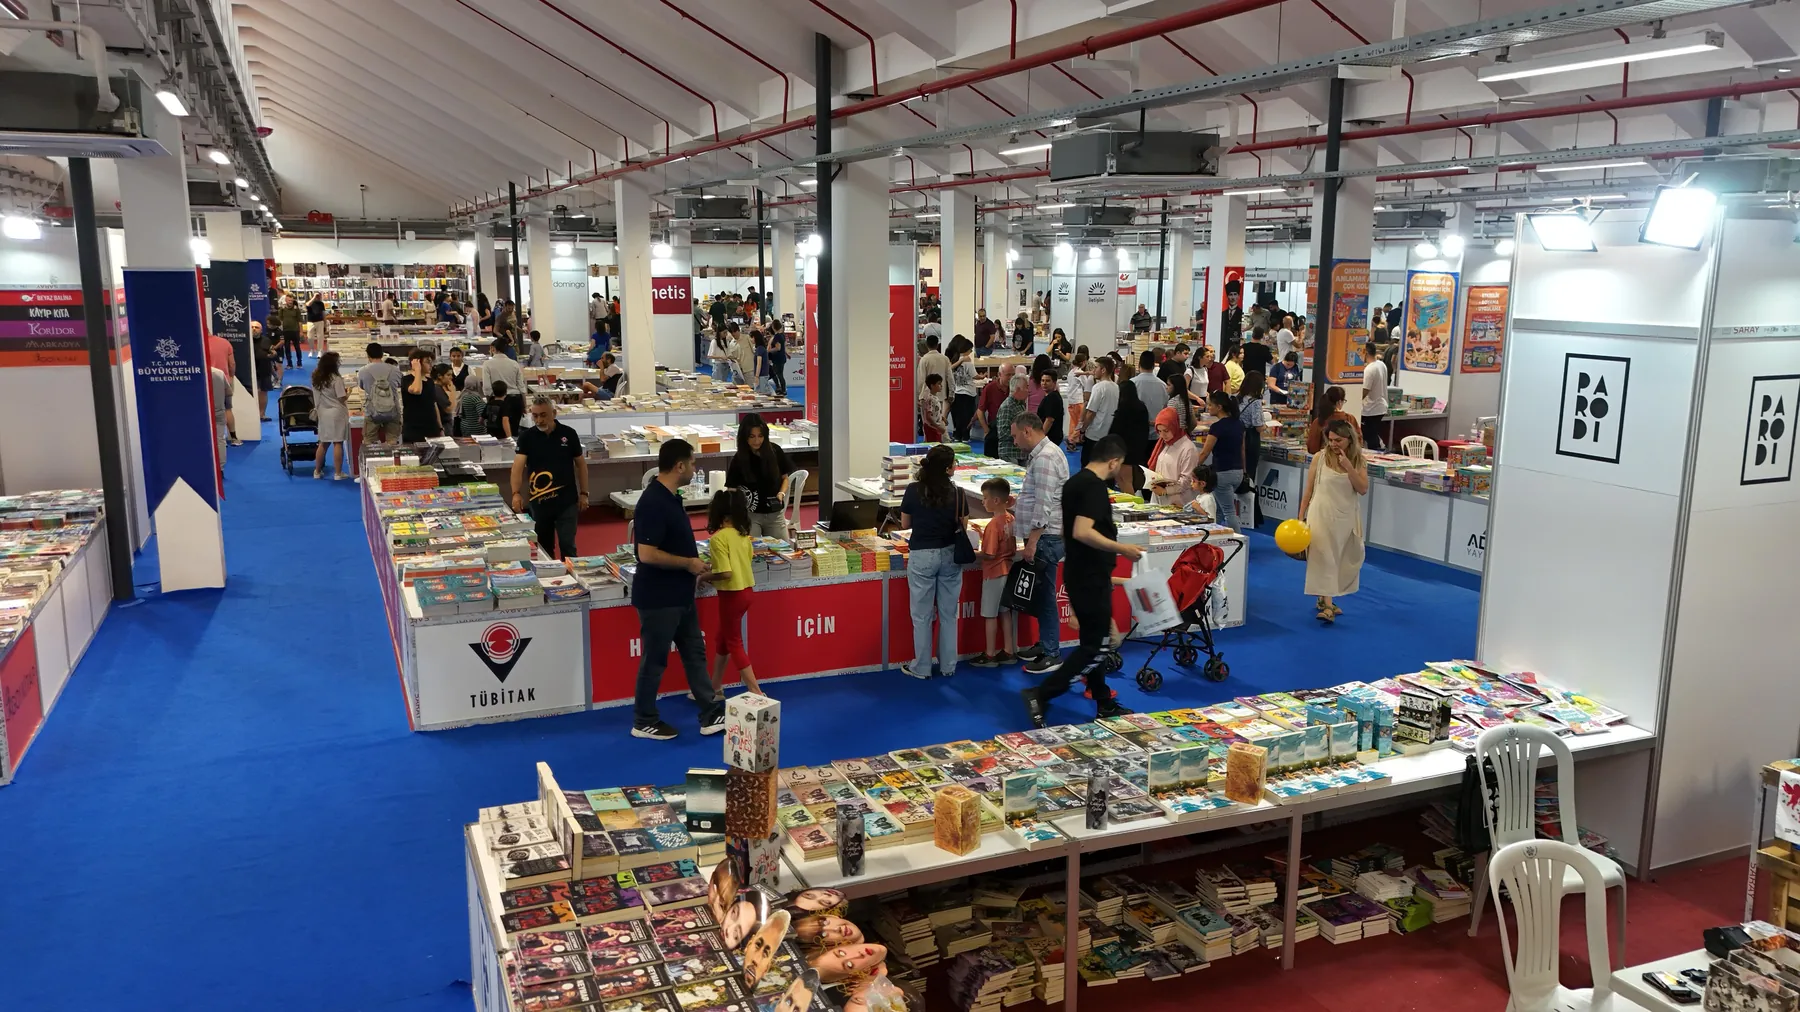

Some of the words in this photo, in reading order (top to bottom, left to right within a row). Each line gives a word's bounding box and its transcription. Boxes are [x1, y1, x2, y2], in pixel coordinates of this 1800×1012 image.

[553, 280, 585, 289] domingo
[1733, 325, 1760, 334] SARAY
[138, 366, 201, 376] BÜYÜKŞEHİR
[797, 613, 836, 639] İÇİN
[470, 688, 536, 708] TÜBİTAK
[1747, 863, 1757, 898] SARAY
[646, 965, 661, 987] NEYMAR
[577, 979, 589, 1002] NEYMAR
[727, 976, 744, 999] BENZEMA
